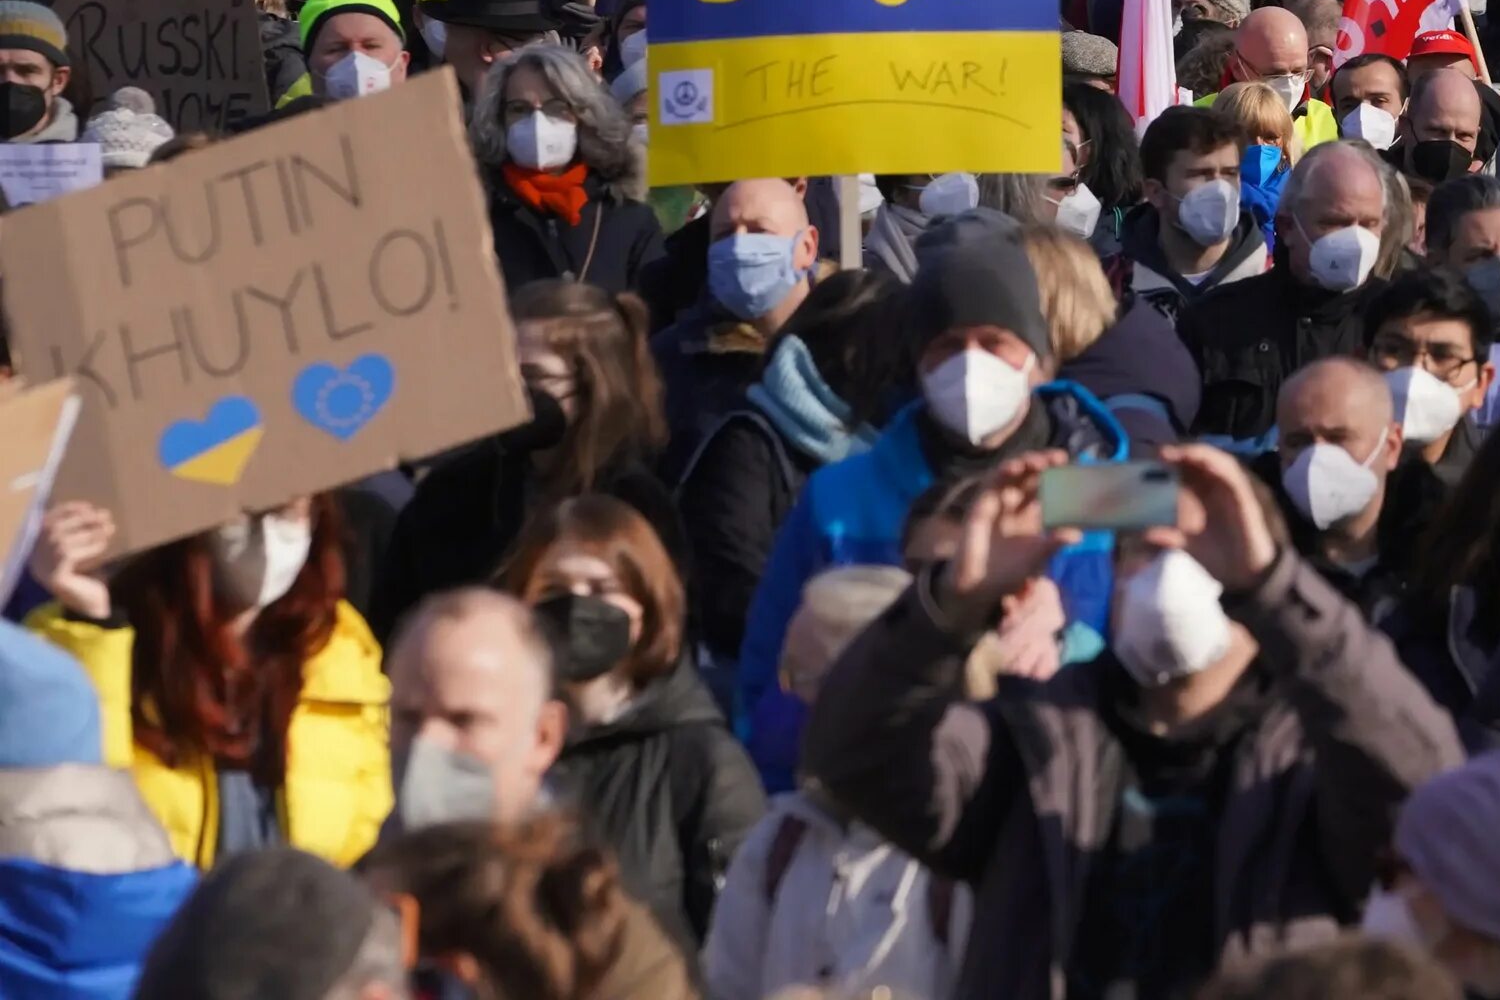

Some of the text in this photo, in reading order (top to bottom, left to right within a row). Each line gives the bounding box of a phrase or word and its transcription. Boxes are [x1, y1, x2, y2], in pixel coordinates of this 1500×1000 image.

[744, 54, 1010, 102] THE WAR!
[107, 131, 363, 289] PUTIN
[50, 216, 460, 409] KHUYLO!
